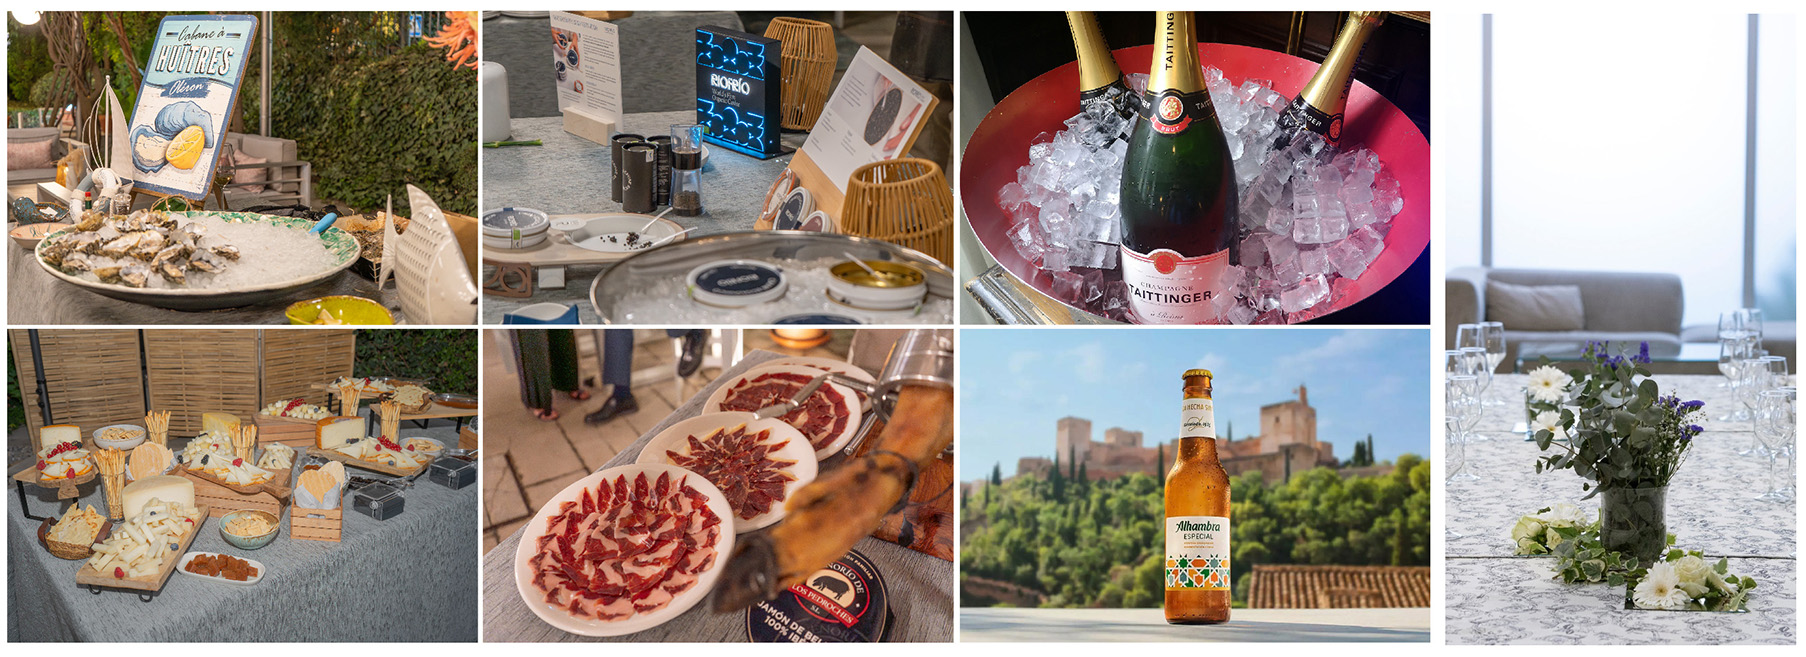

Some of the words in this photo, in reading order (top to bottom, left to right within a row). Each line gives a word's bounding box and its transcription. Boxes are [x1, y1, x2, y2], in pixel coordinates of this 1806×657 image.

[178, 24, 215, 41] Cabane
[217, 26, 225, 38] à
[155, 41, 235, 76] HUÎTRES
[1129, 283, 1212, 304] TAITTINGER
[1140, 282, 1194, 291] CHAMPAGNE
[1175, 520, 1221, 533] Alhambra
[854, 559, 874, 580] FAMILIAR
[853, 580, 865, 594] DE
[791, 583, 808, 595] LOS
[808, 590, 854, 624] PEDROCHES
[757, 600, 791, 625] JAMÓN
[789, 621, 806, 635] DE
[763, 616, 789, 637] 100%
